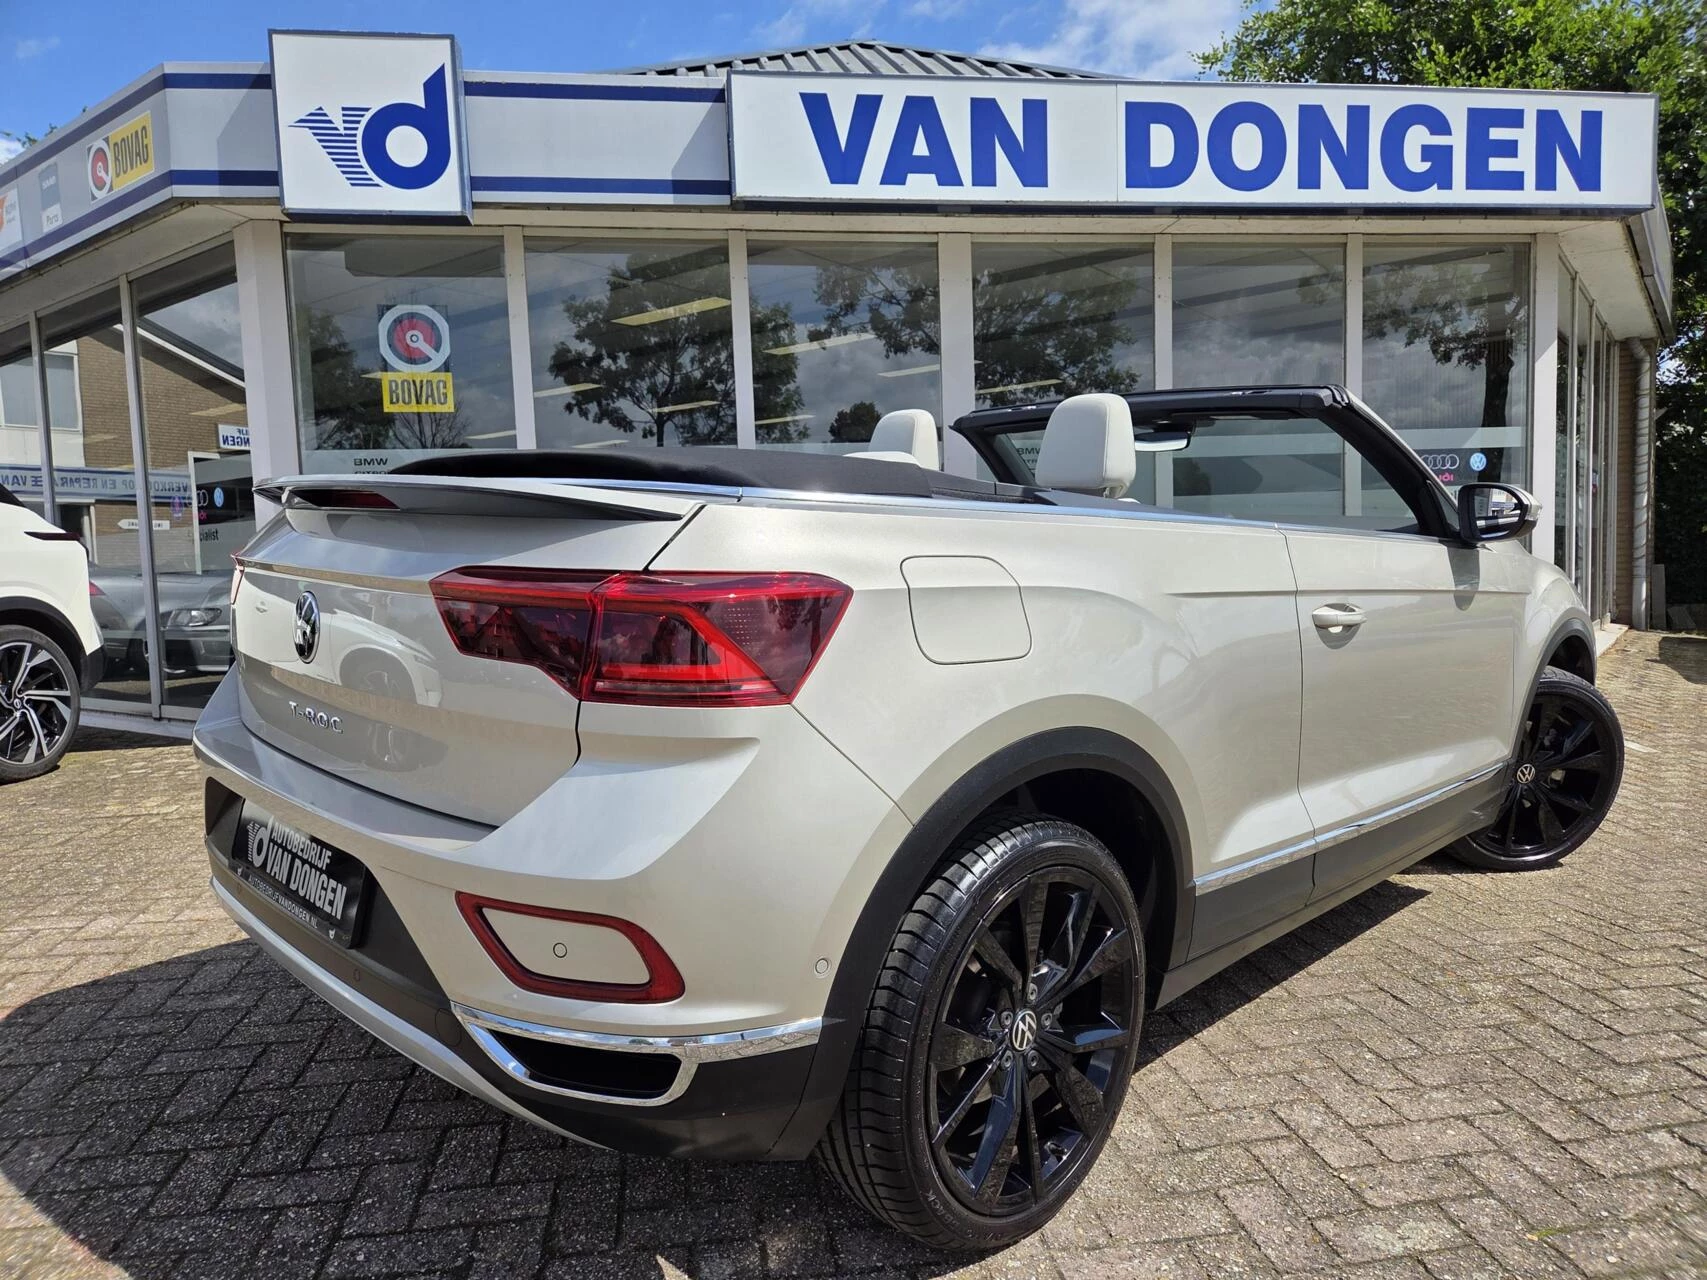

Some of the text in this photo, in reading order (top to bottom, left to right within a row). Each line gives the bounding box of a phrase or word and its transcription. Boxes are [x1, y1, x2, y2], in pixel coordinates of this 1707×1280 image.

[113, 125, 149, 178] BOVAG
[799, 92, 1602, 192] VAN DONGEN
[388, 379, 447, 405] BOVAG
[354, 458, 388, 466] BMW
[289, 701, 344, 734] T-ROC
[271, 822, 332, 870] AUTOBEDRIJF
[266, 842, 347, 920] VAN DONGEN
